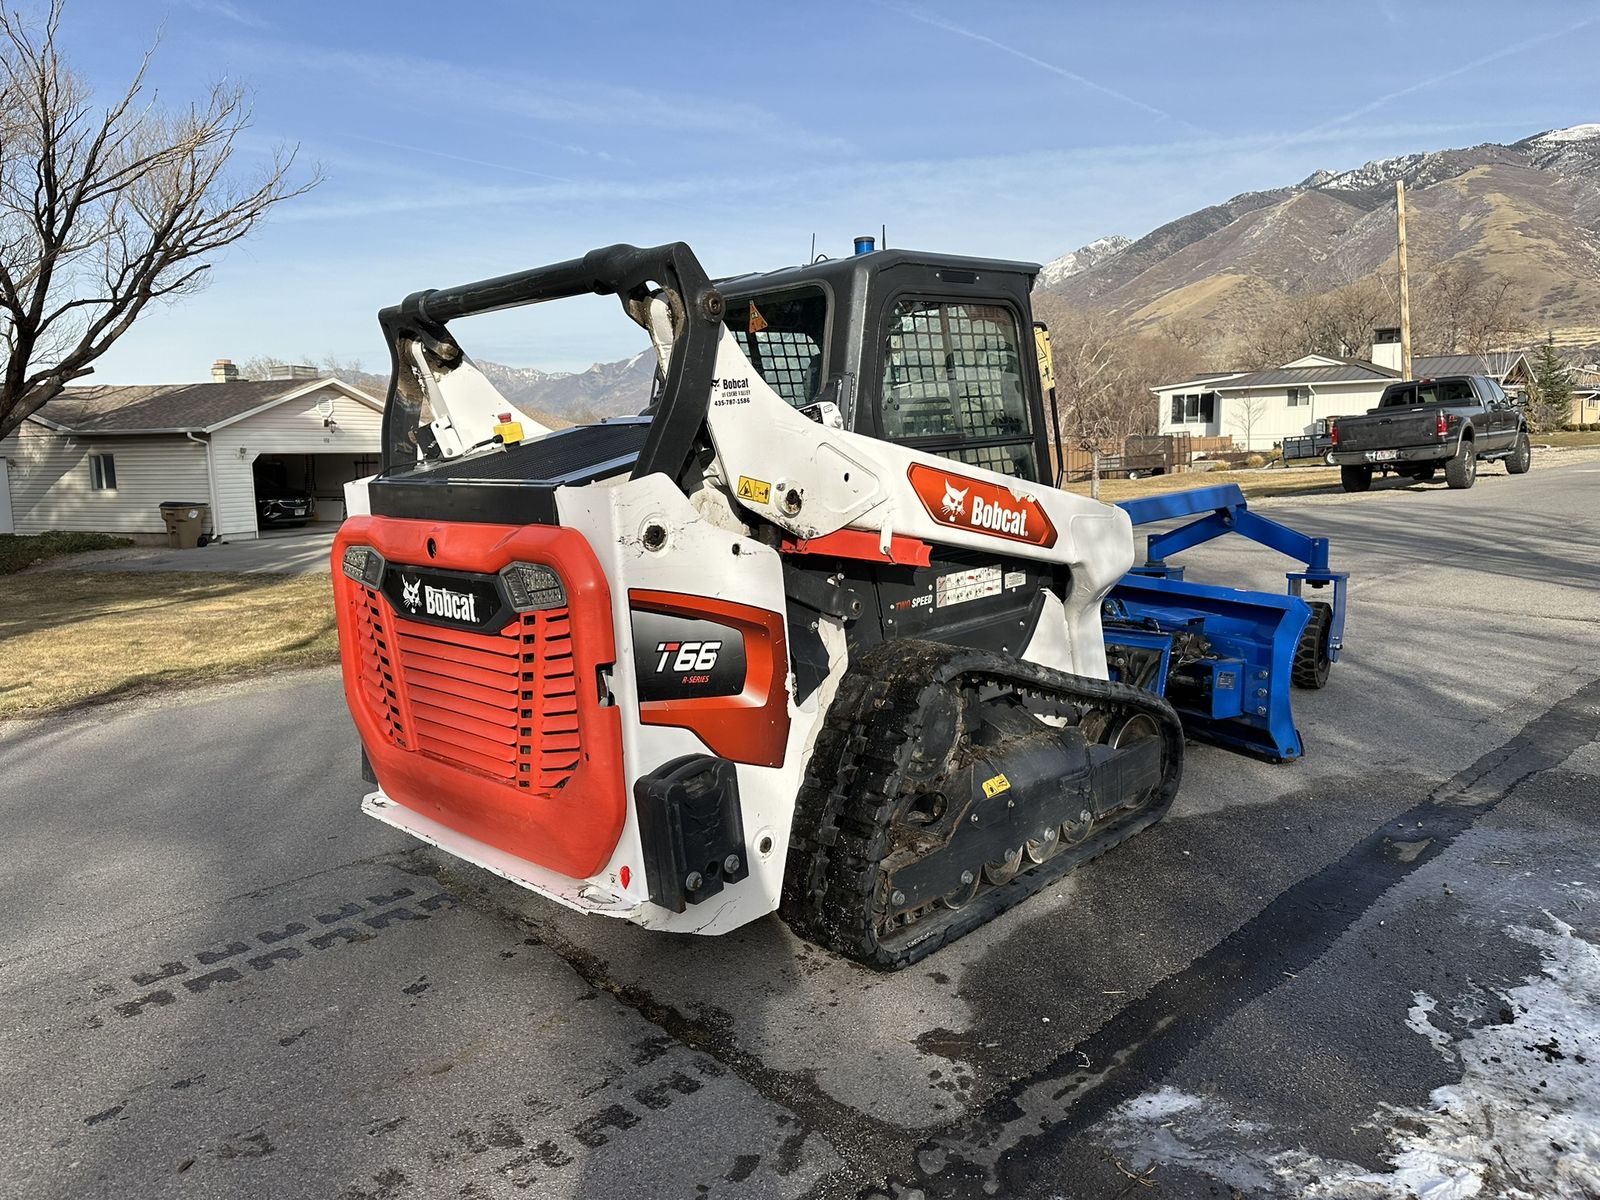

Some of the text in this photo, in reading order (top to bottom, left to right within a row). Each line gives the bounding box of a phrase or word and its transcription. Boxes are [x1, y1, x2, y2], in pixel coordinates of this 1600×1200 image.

[722, 378, 749, 389] Bobcat
[971, 495, 1027, 536] Bobcat
[424, 585, 477, 622] Bobcat
[896, 595, 933, 611] TWO SPEED
[656, 642, 722, 672] T66
[681, 675, 710, 684] R-SERIES
